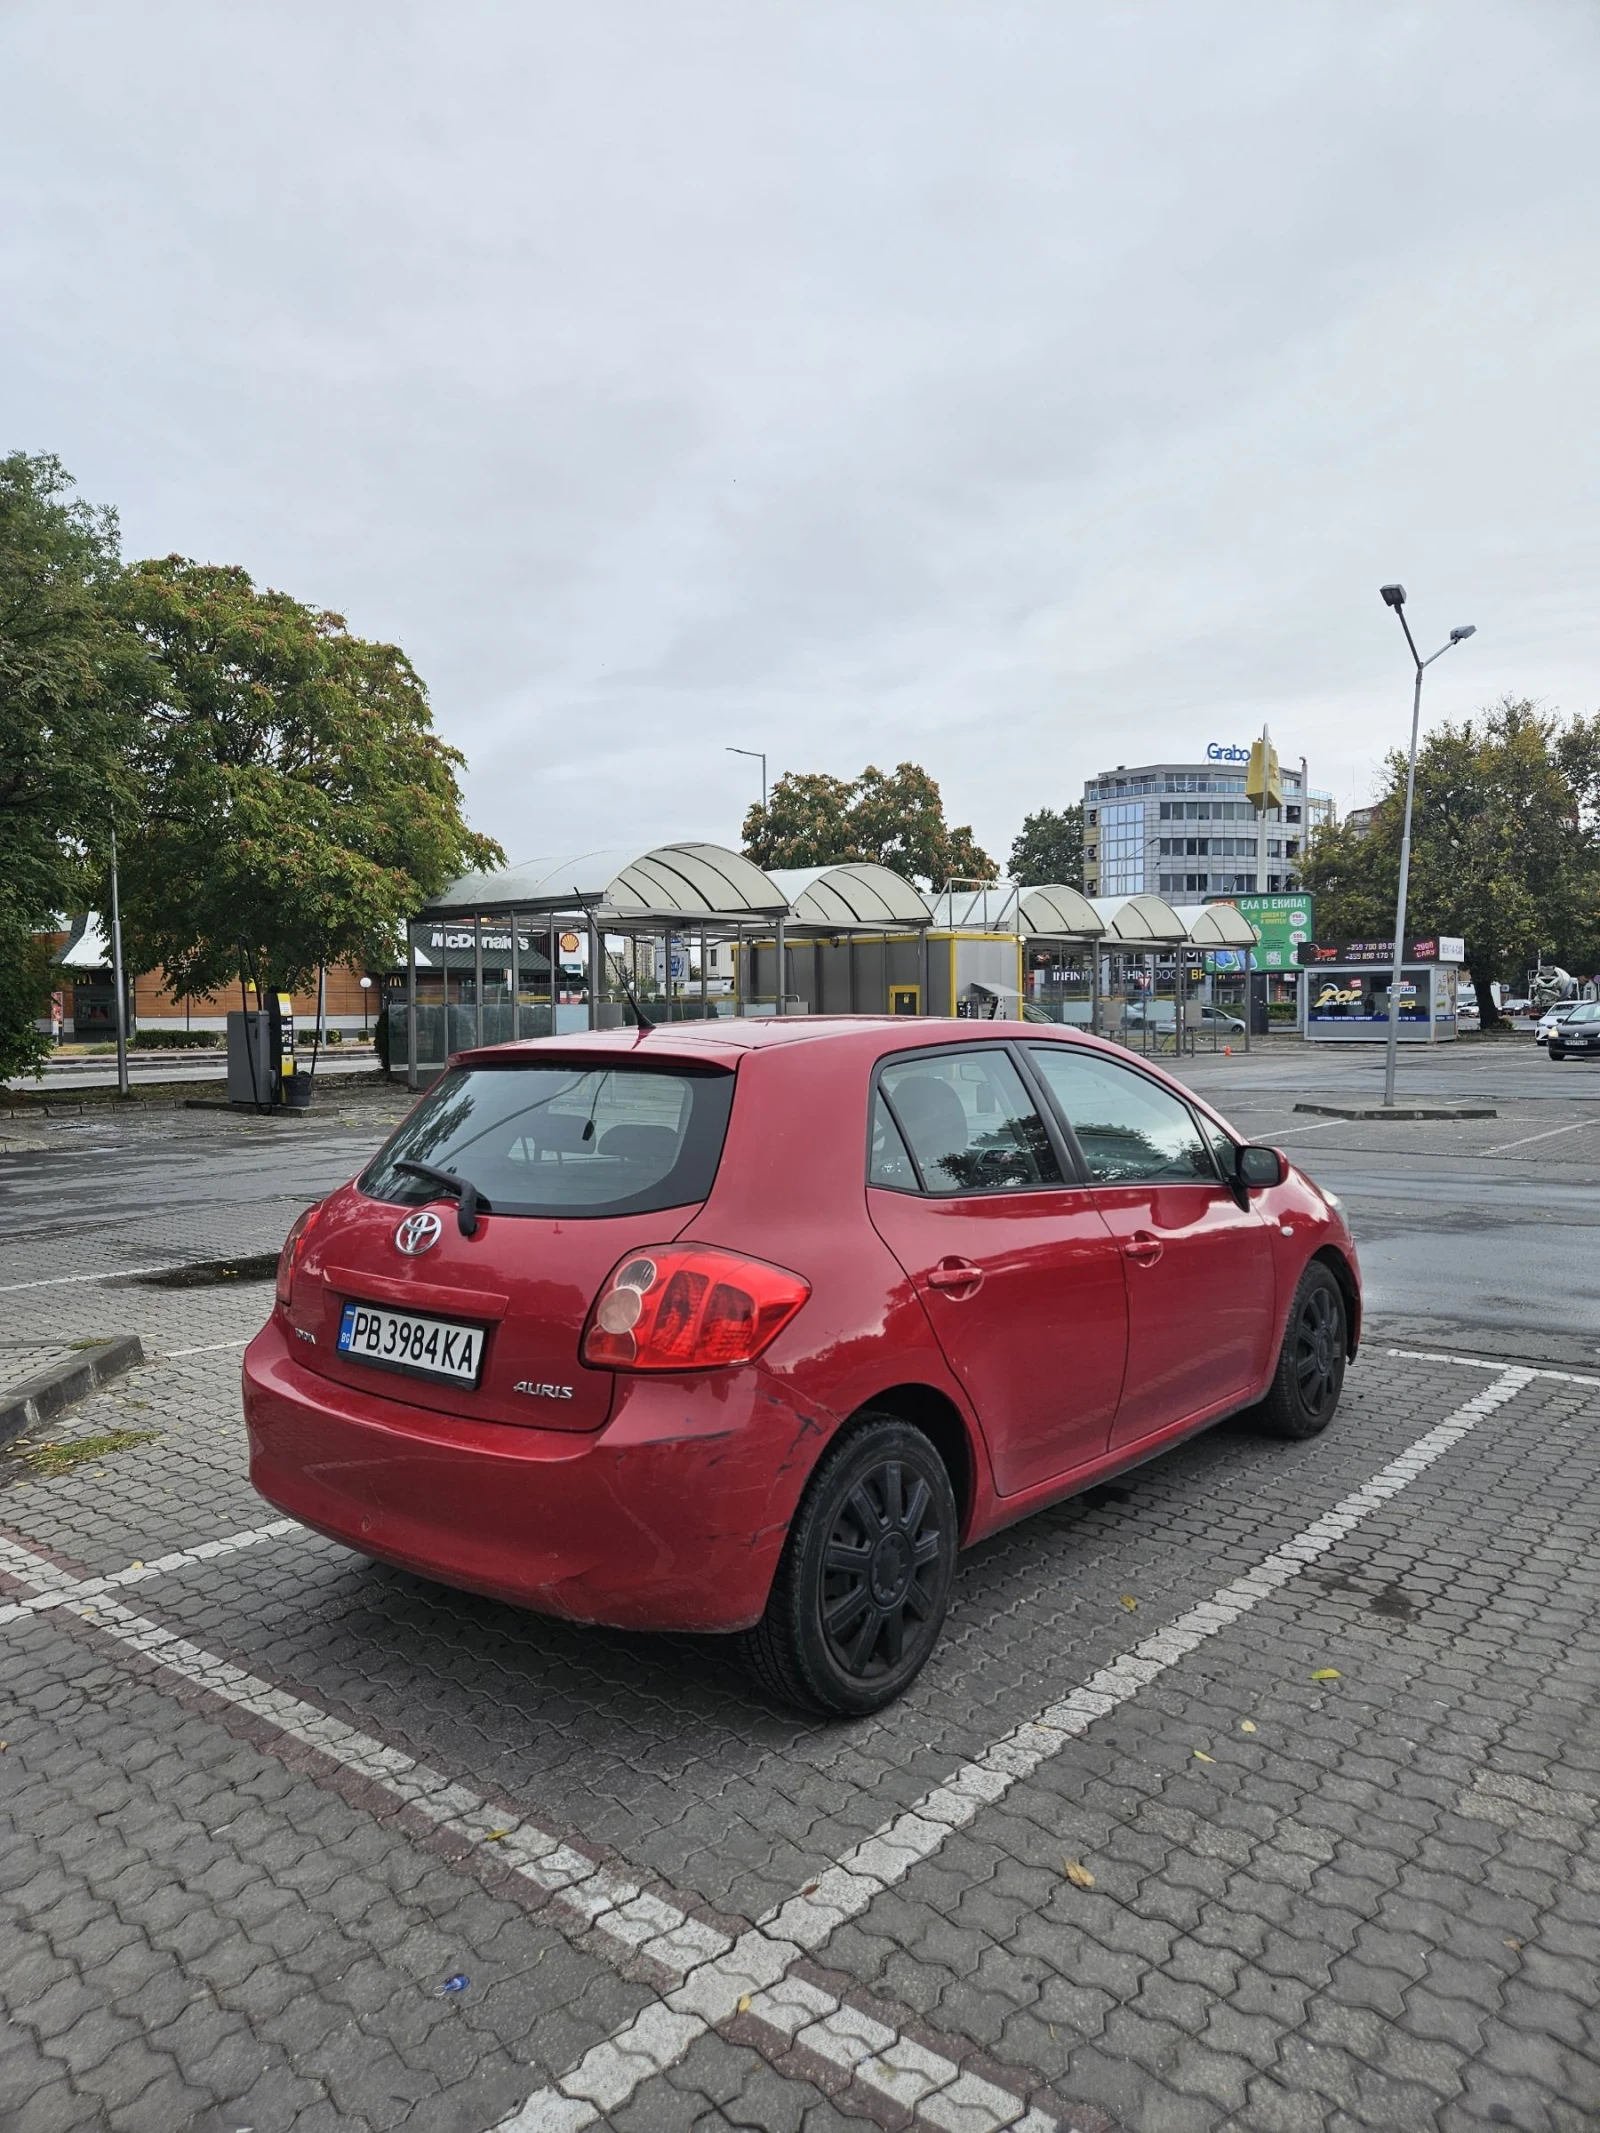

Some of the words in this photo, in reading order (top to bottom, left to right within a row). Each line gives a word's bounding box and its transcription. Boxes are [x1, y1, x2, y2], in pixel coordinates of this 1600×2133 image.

[1207, 743, 1251, 761] Grabo
[1241, 900, 1259, 910] ЕЛА
[1263, 899, 1268, 909] В
[1272, 898, 1306, 909] ЕКИПА!
[1314, 988, 1362, 1008] TOP
[340, 1332, 350, 1343] BG
[352, 1312, 472, 1373] PB3984KA
[513, 1381, 573, 1399] AURIS
